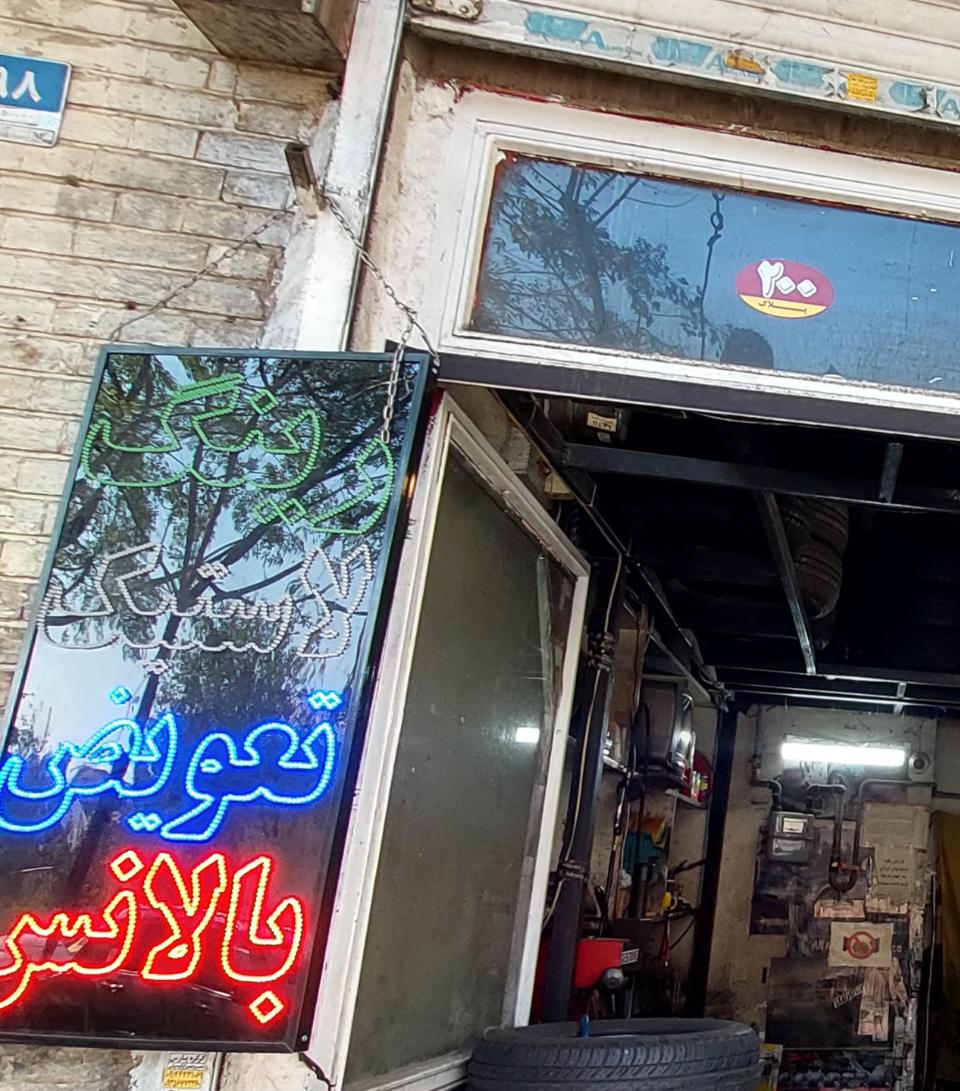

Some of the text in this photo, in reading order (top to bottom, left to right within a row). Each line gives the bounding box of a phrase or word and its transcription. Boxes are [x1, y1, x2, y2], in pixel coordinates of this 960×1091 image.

[757, 260, 817, 298] ۲۰۰
[758, 300, 807, 314] پلاک
[82, 373, 394, 535] رینگ
[37, 543, 374, 674] لاستیک
[0, 686, 342, 841] تعویض
[0, 849, 304, 1024] بالانس
